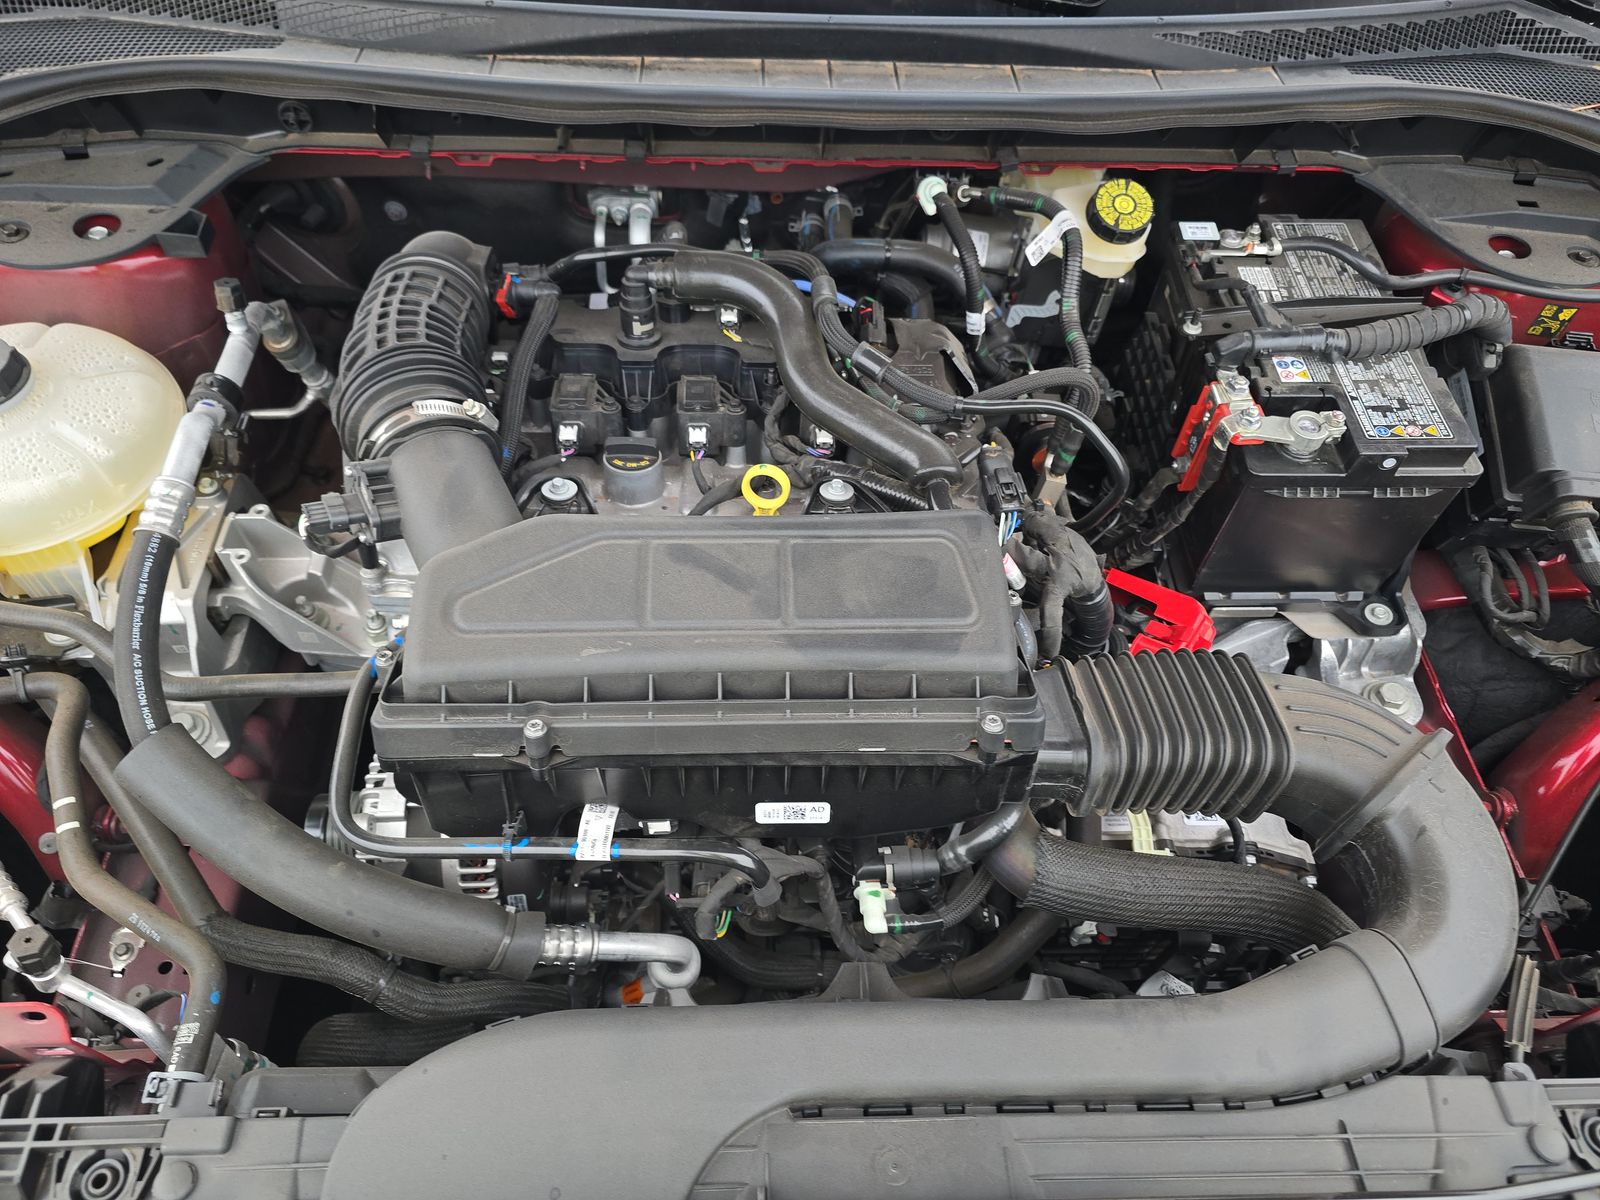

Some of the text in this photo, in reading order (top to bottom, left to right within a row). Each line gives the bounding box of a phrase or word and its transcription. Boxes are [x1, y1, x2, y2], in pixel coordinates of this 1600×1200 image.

[136, 595, 146, 603] in
[131, 605, 145, 650] Flexbarrier
[132, 653, 143, 667] A/C
[134, 669, 149, 706] SUCTION
[141, 706, 157, 730] HOSE
[809, 805, 826, 813] AD
